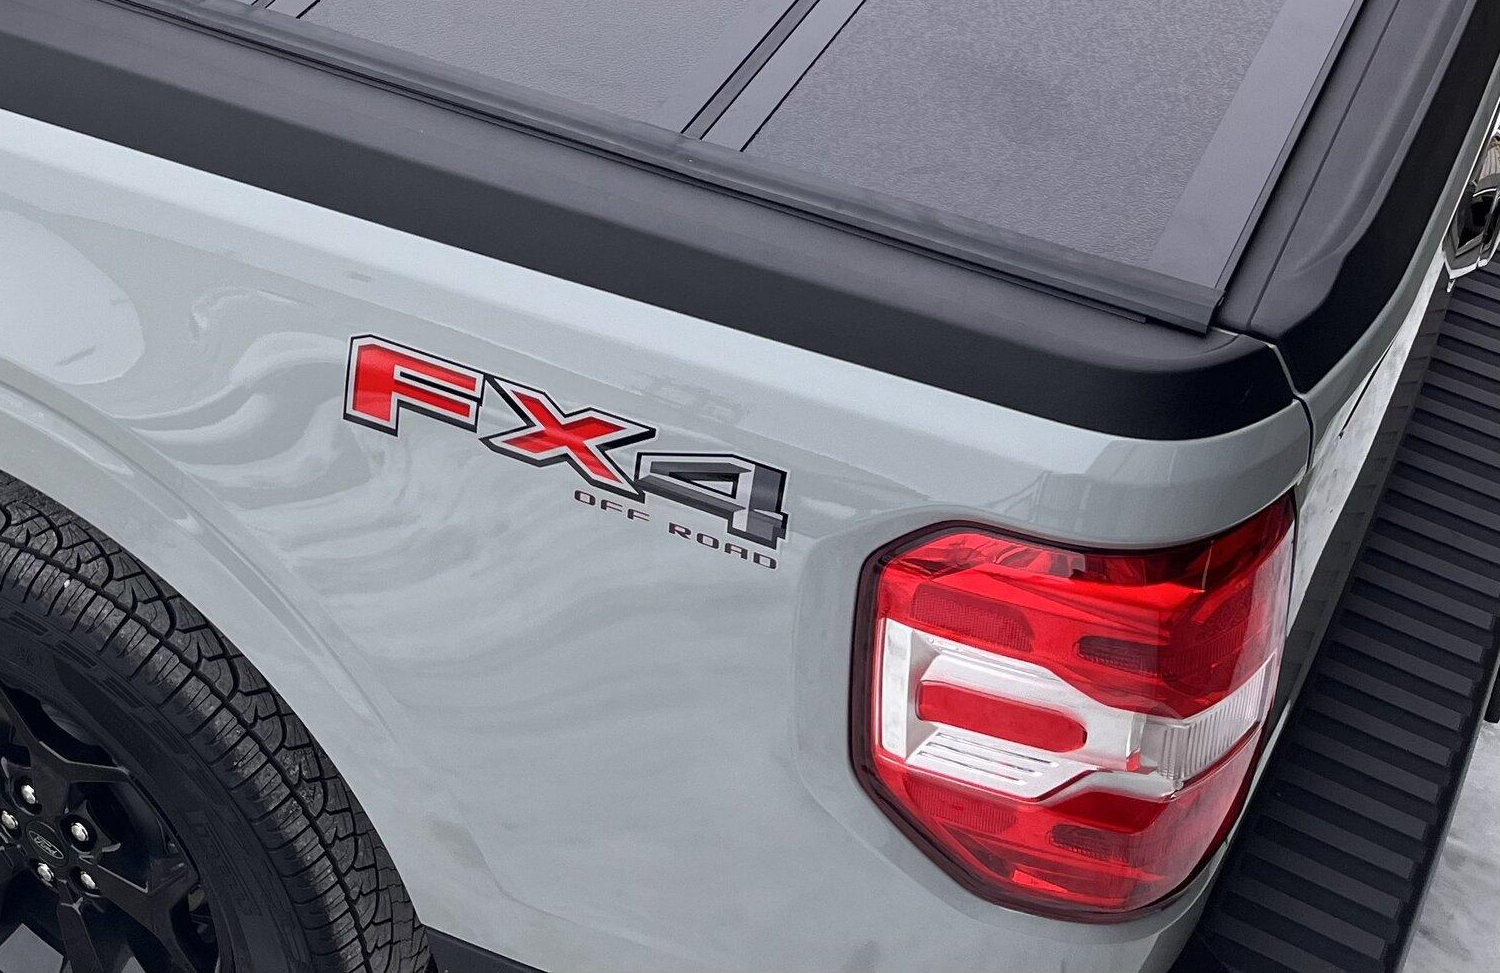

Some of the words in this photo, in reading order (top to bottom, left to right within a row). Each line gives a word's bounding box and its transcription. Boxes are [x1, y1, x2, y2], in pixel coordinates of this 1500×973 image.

[343, 334, 788, 550] FX4
[574, 489, 650, 522] OFF
[668, 522, 778, 570] ROAD
